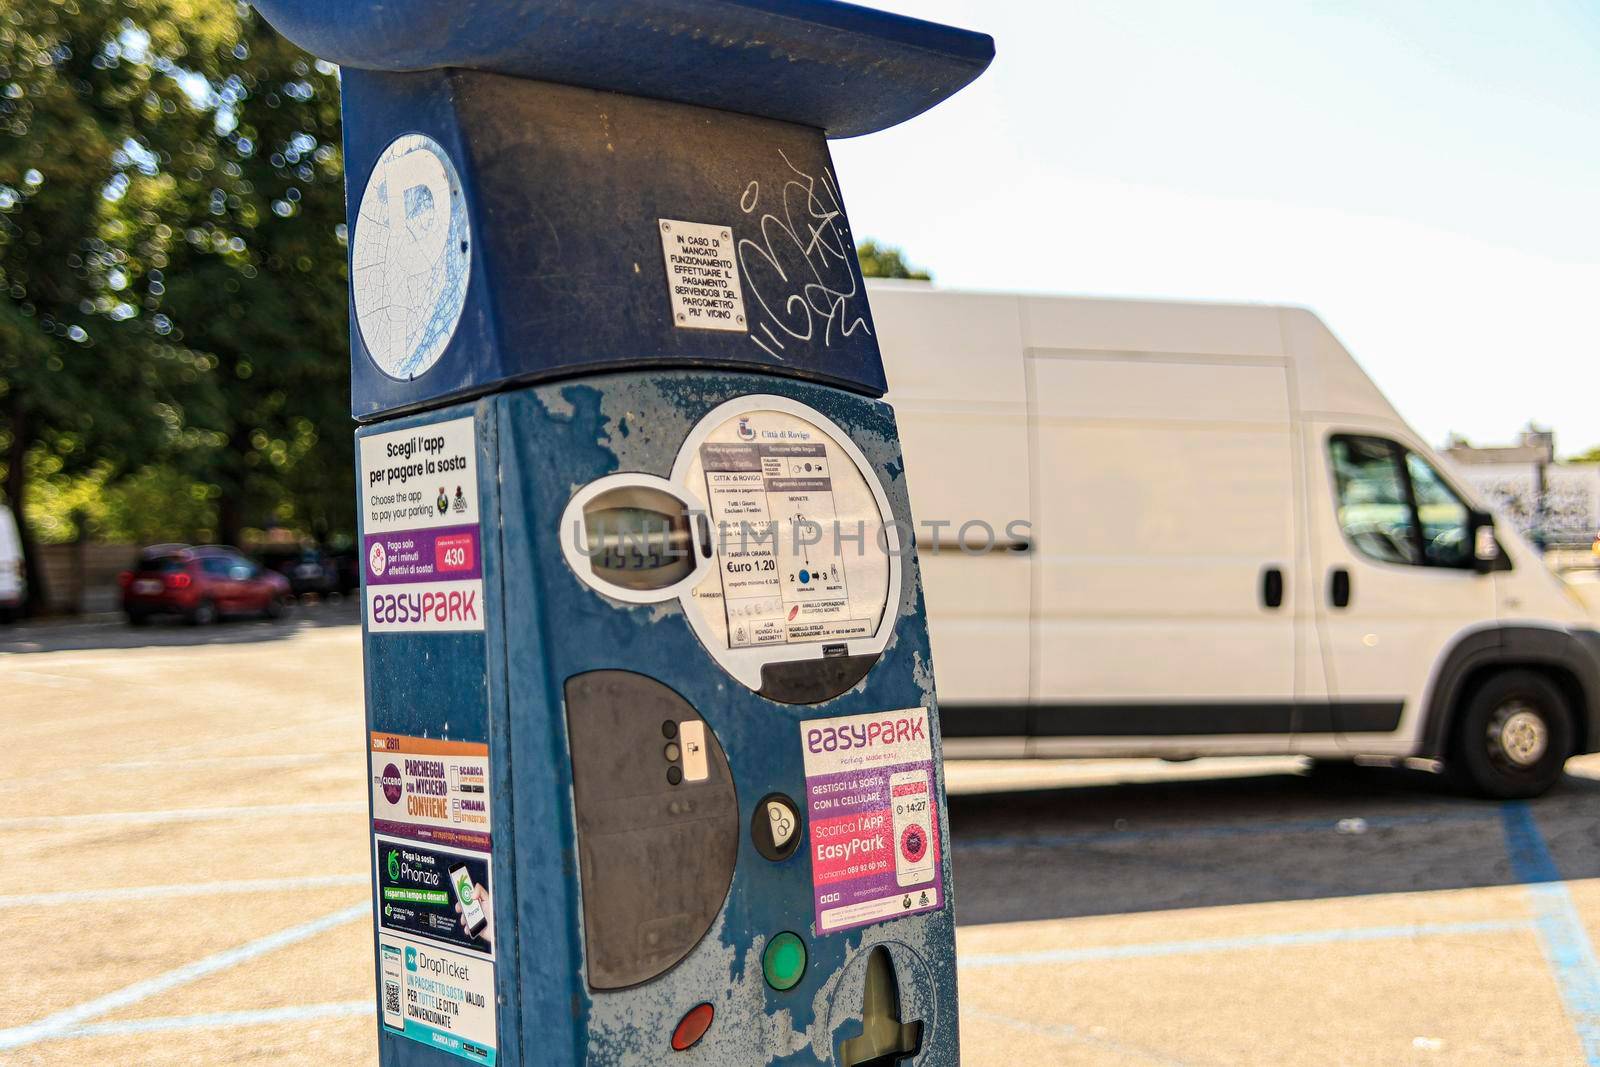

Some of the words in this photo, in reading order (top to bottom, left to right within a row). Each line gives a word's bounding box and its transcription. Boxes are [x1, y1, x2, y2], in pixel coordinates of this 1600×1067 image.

[677, 235, 684, 243] IN
[688, 236, 708, 246] CASO
[712, 239, 720, 248] DI
[682, 246, 718, 257] MANCATO
[671, 254, 732, 269] FUNZIONAMENTO
[674, 265, 722, 278] EFFETTUARE
[725, 270, 732, 279] IL
[682, 276, 728, 288] PAGAMENTO
[675, 286, 720, 298] SERVENDOSI
[724, 290, 738, 300] DEL
[682, 297, 733, 309] PARCOMETRO
[706, 310, 730, 320] VICINO
[762, 430, 778, 439] Città
[780, 430, 786, 439] di
[788, 430, 810, 440] Rovigo
[387, 438, 416, 460] Scegli
[418, 435, 444, 456] l'app
[370, 470, 384, 488] per
[388, 464, 423, 485] pagare
[425, 459, 436, 474] la
[438, 456, 466, 472] sosta
[370, 494, 395, 506] Choose
[396, 492, 407, 504] the
[408, 490, 422, 504] app
[371, 511, 378, 521] to
[379, 510, 392, 523] pay
[392, 508, 407, 522] your
[408, 504, 434, 520] parking
[403, 538, 414, 550] solo
[388, 555, 397, 564] per
[401, 550, 419, 562] minuti
[444, 547, 465, 566] 430
[727, 562, 752, 573] €uro
[755, 560, 775, 571] 1.20
[822, 572, 828, 580] 3
[386, 737, 400, 750] 2811
[404, 759, 445, 779] PARCHEGGIA
[459, 766, 483, 776] SCARICA
[416, 779, 447, 796] MYCICERO
[848, 781, 858, 791] LA
[858, 777, 883, 790] SOSTA
[407, 795, 448, 819] CONVIENE
[461, 800, 485, 812] CHIAMA
[814, 800, 831, 810] CON
[833, 799, 840, 808] IL
[841, 792, 881, 807] CELLULARE
[906, 800, 926, 814] 14:27
[816, 823, 856, 839] Scarica
[858, 816, 884, 831] l'APP
[817, 836, 884, 862] EasyPark
[402, 850, 414, 862] Paga
[415, 852, 420, 862] la
[421, 854, 435, 864] sosta
[401, 862, 439, 886] Phonzie
[824, 868, 846, 878] chiama
[420, 953, 470, 981] DropTicket
[407, 975, 414, 986] UN
[446, 986, 464, 1000] SOSTA
[464, 990, 485, 1008] VALIDO
[407, 989, 418, 1002] PER
[418, 992, 436, 1008] TUTTE
[436, 997, 442, 1011] LE
[407, 1004, 451, 1029] CONVENZIONATE
